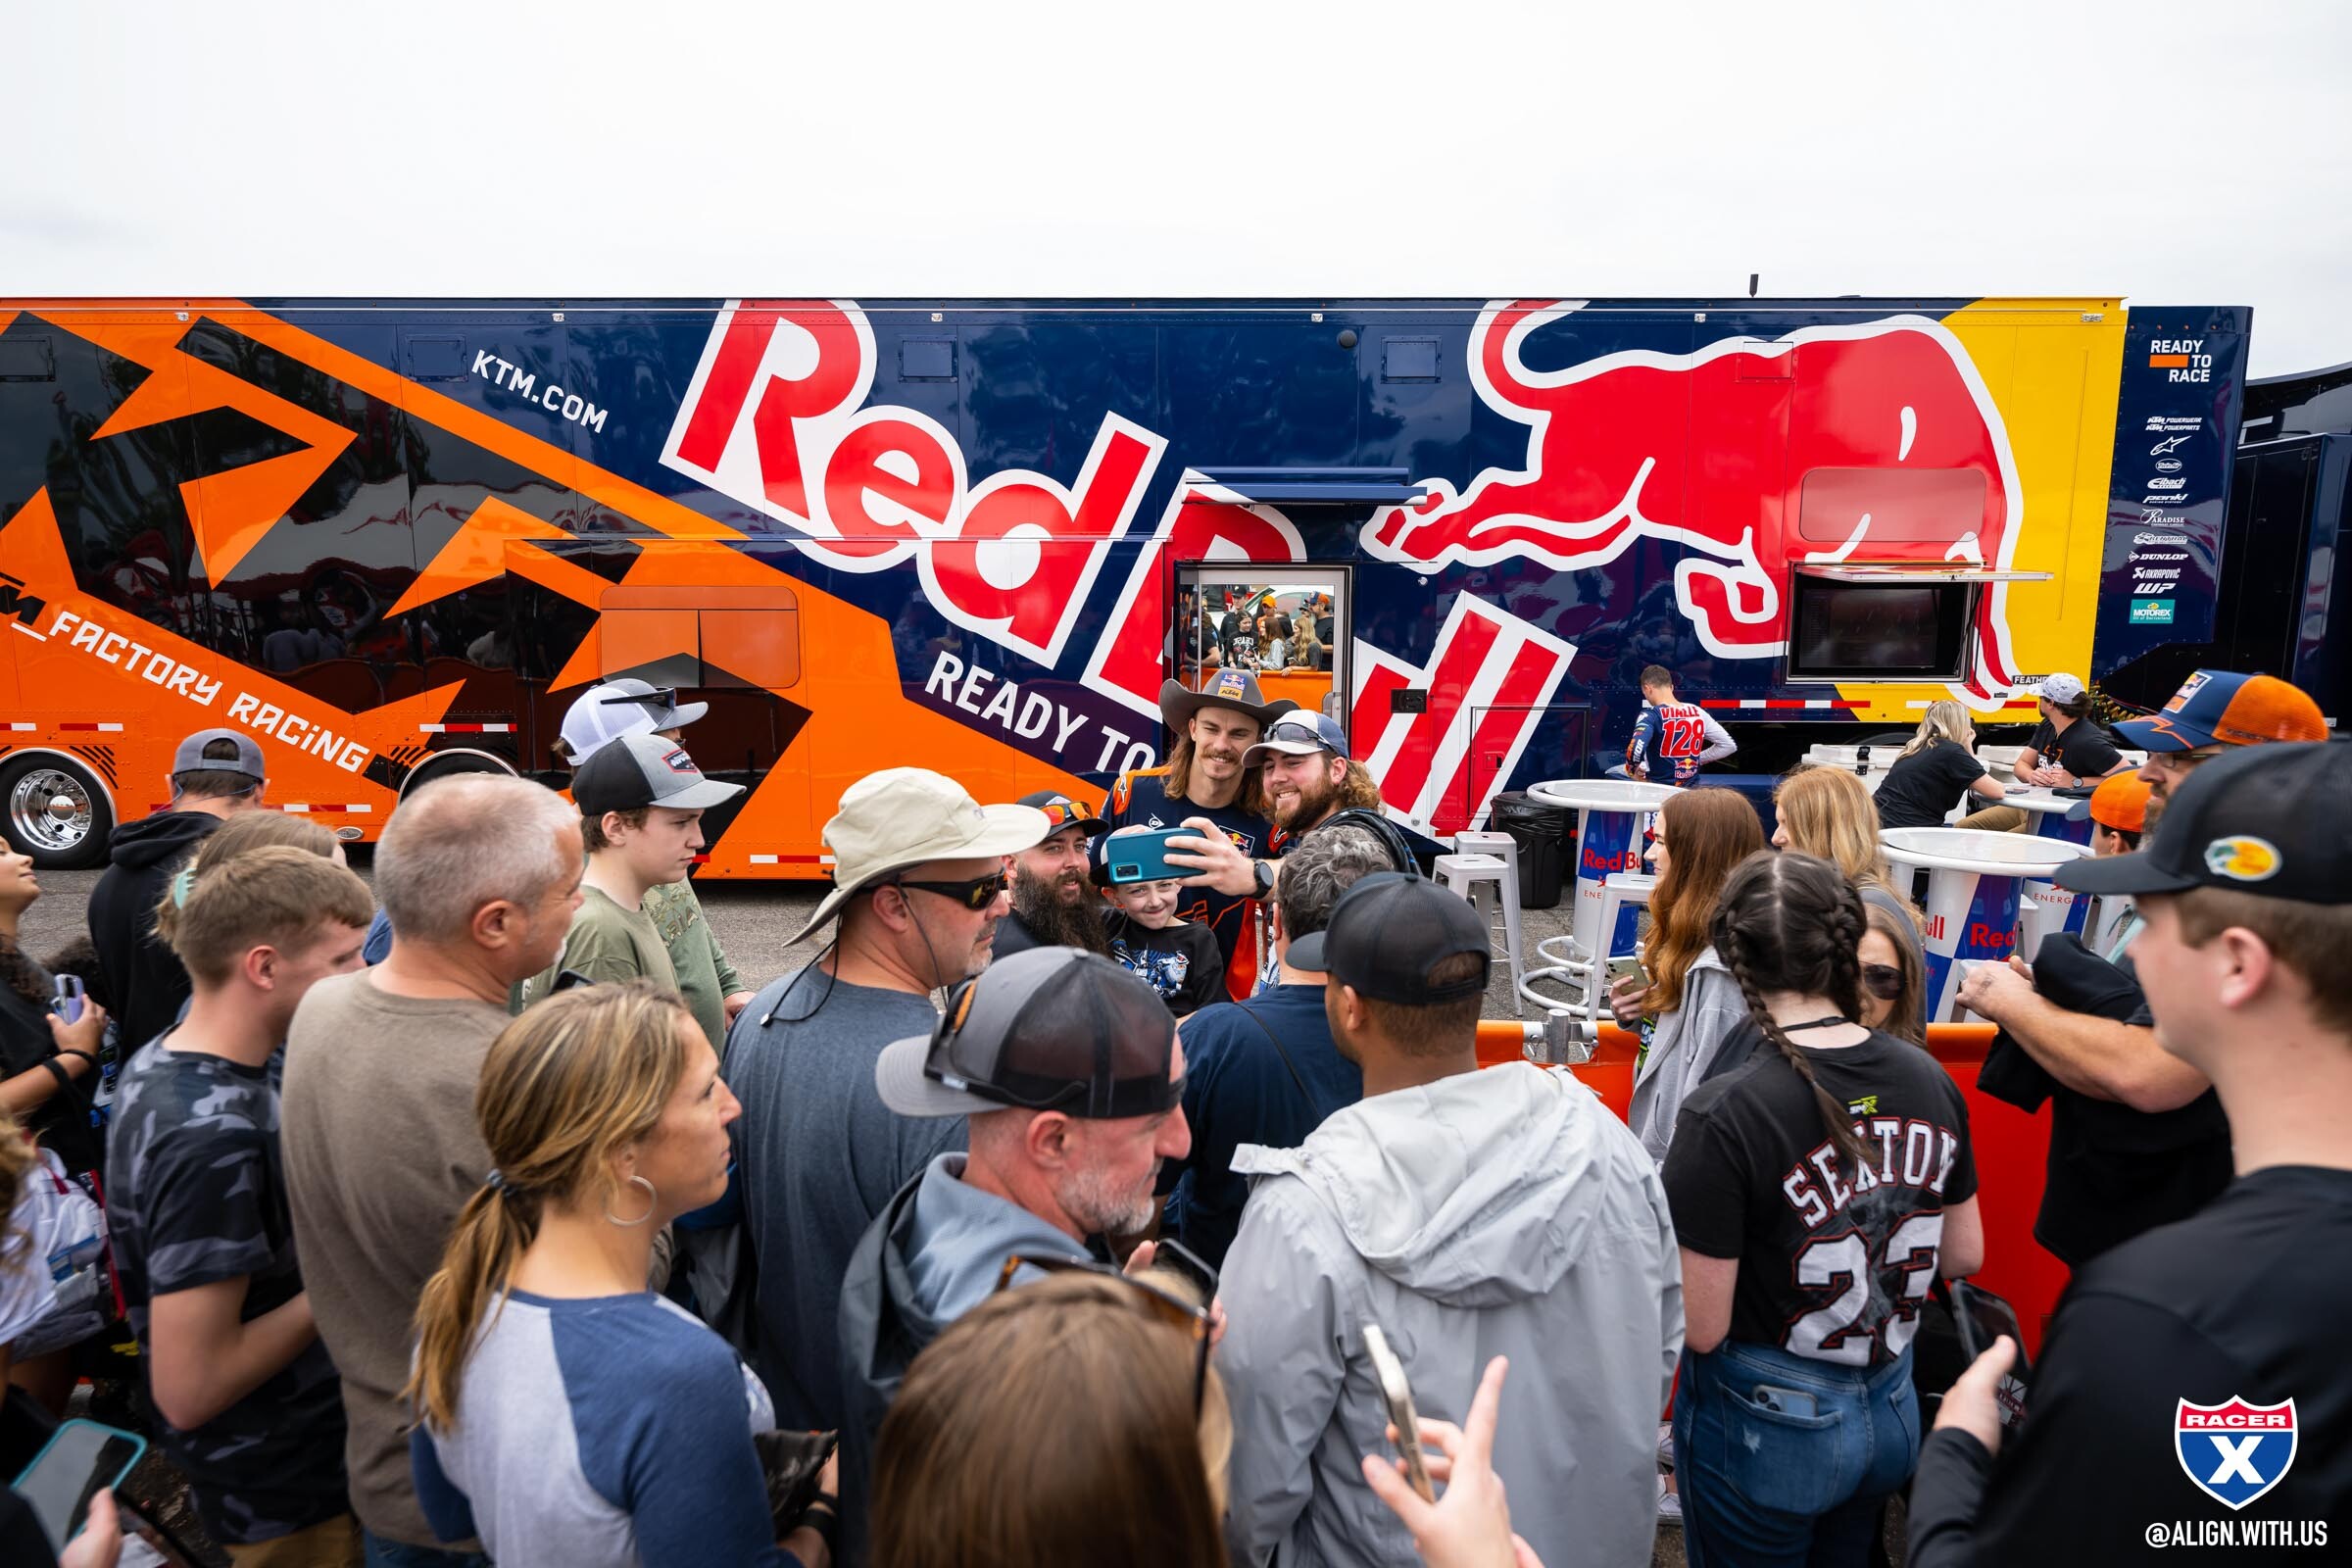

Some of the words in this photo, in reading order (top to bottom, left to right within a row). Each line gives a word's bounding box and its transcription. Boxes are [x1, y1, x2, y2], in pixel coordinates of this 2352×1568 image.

[2150, 340, 2203, 354] READY
[2191, 355, 2212, 368] TO
[2169, 369, 2211, 382] RACE
[471, 349, 609, 434] KTM.COM
[658, 299, 1169, 670] Red
[2133, 583, 2176, 594] WP
[924, 650, 1090, 754] READY
[1095, 725, 1156, 777] TO
[1633, 739, 1645, 762] THOR
[1659, 718, 1705, 759] 128
[1583, 848, 1623, 871] Red
[1625, 852, 1642, 870] Bu
[1584, 889, 1603, 900] ENE
[1926, 914, 1945, 940] ull
[1970, 922, 2018, 948] Red
[1779, 1208, 1945, 1368] 23
